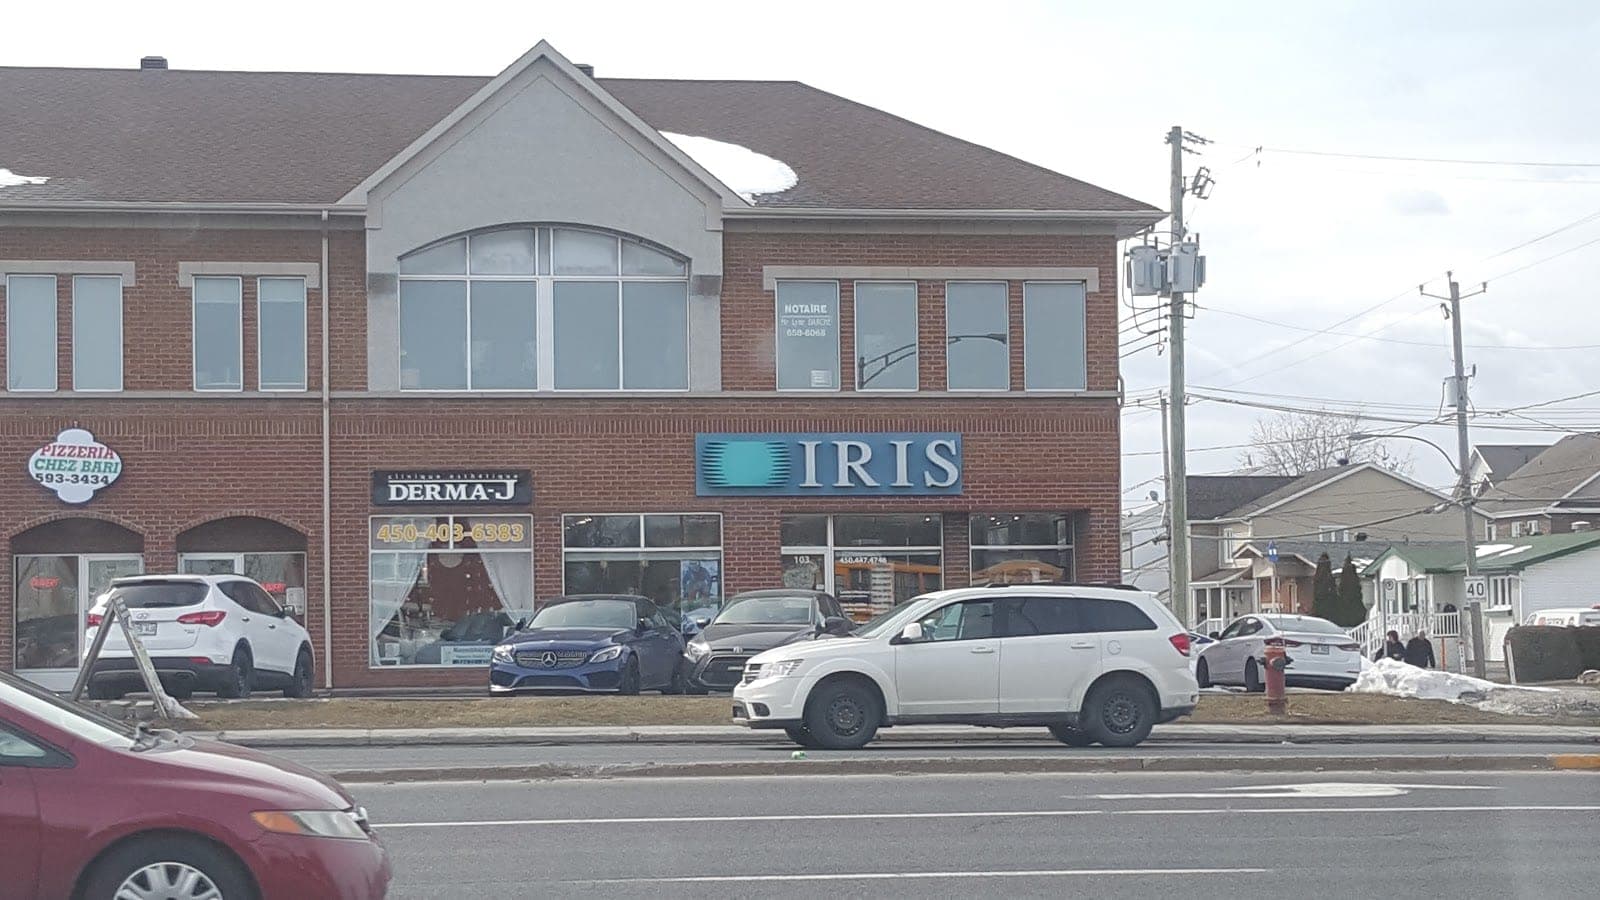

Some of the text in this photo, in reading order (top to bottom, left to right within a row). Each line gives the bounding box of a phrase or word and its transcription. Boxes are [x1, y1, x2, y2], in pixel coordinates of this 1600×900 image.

[784, 303, 827, 314] NOTAIRE
[40, 444, 115, 459] PIZZERIA
[34, 458, 120, 474] CHEZ BARI
[798, 439, 959, 489] IRIS
[35, 473, 110, 485] 593-3434
[388, 480, 518, 501] DERMA-J
[377, 523, 524, 543] 450-403-6383
[793, 555, 810, 564] 103
[1467, 582, 1485, 596] 40
